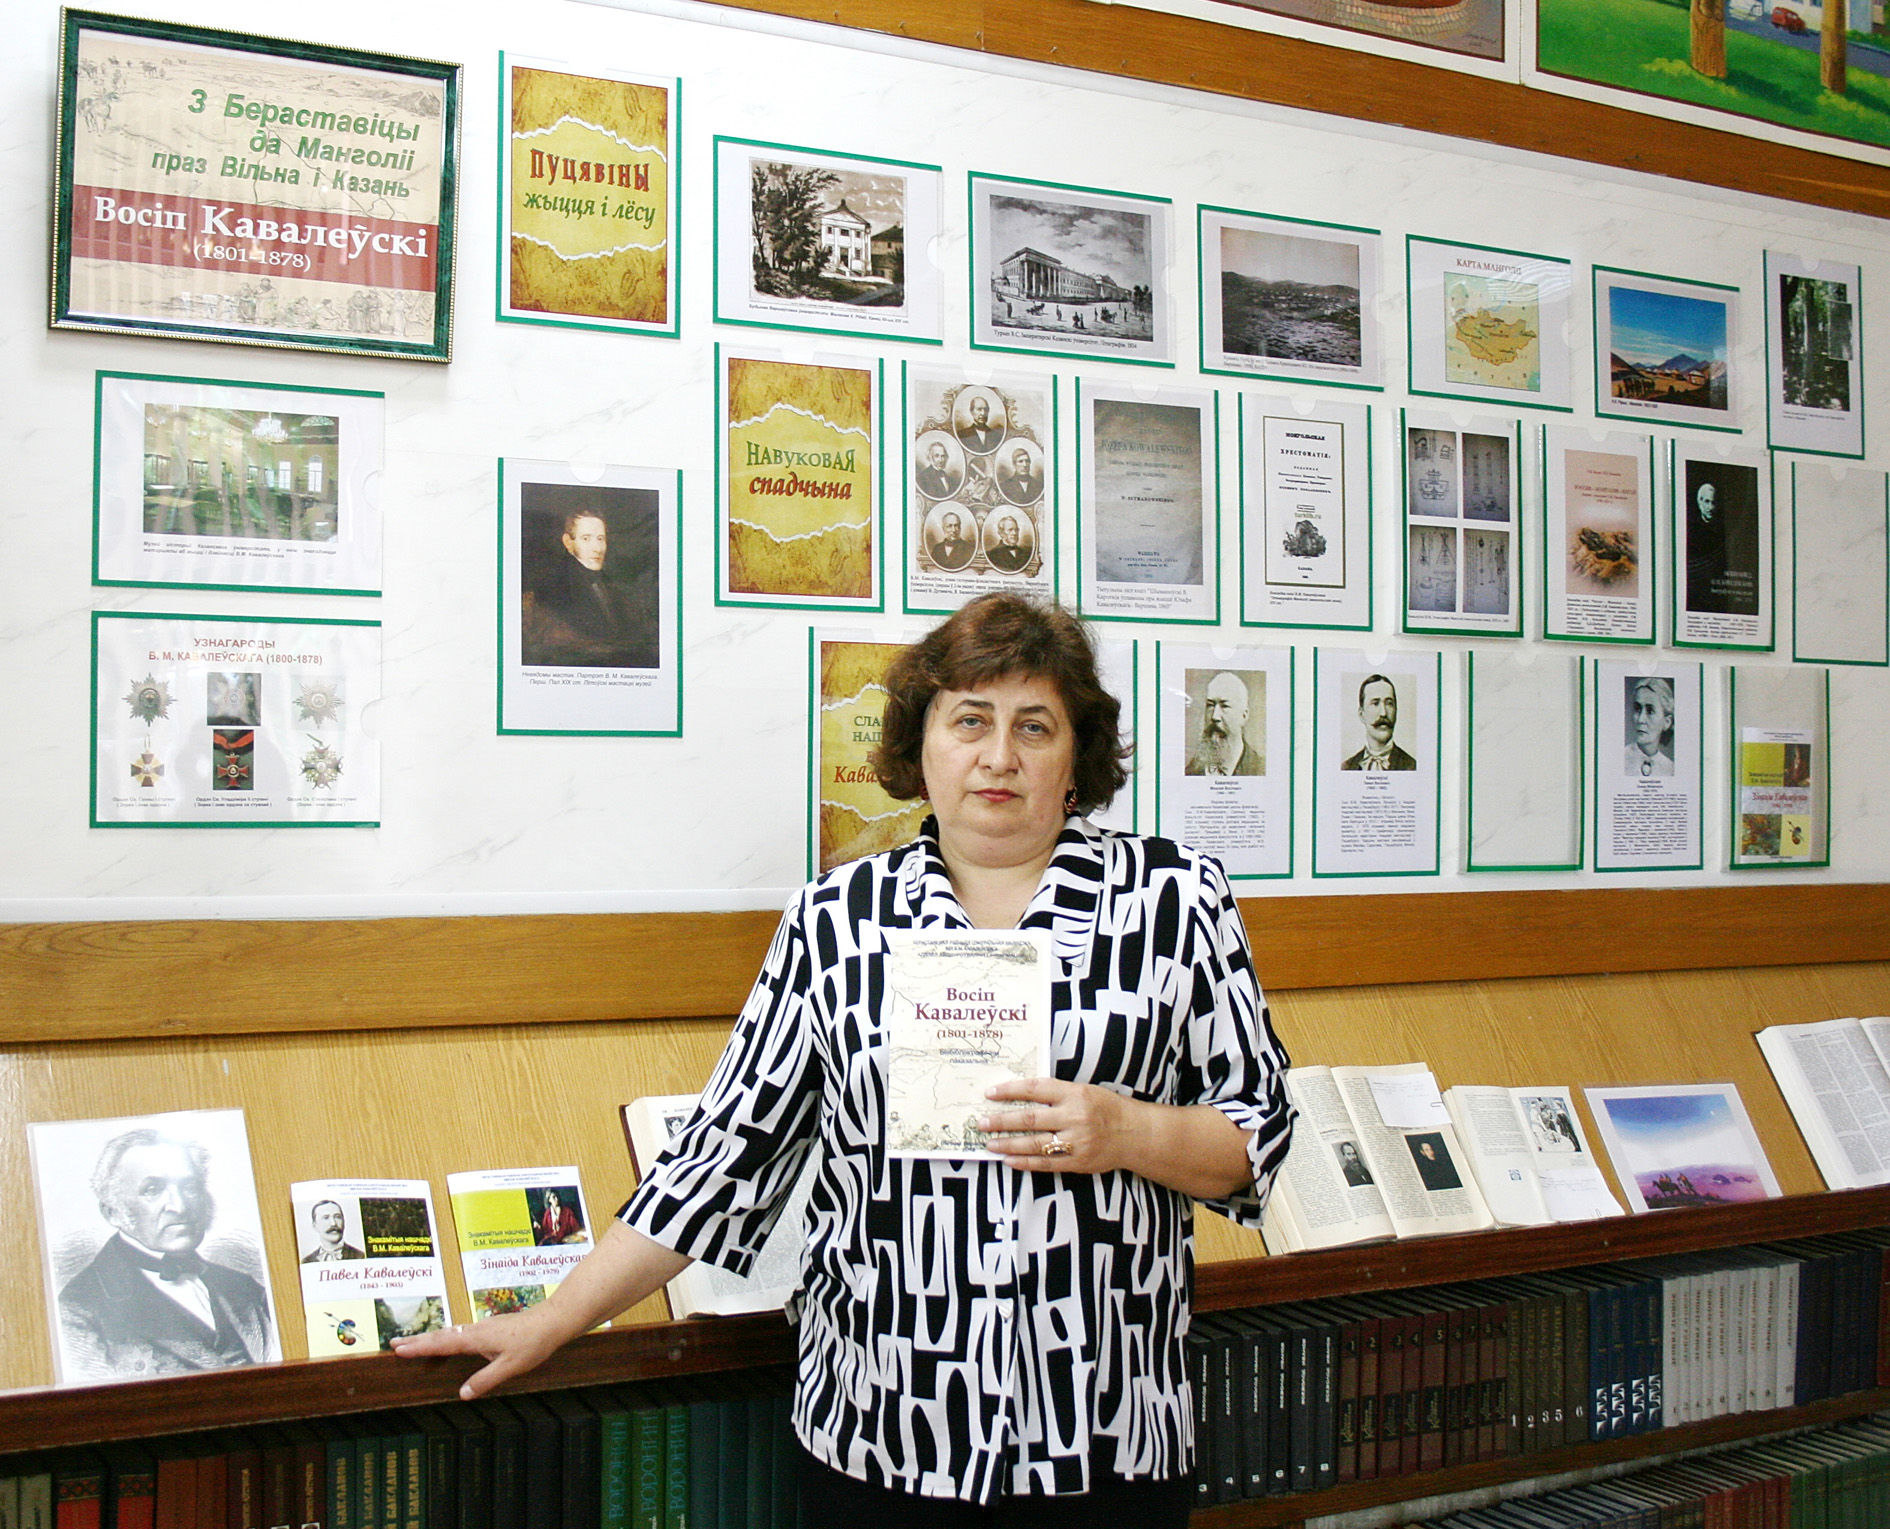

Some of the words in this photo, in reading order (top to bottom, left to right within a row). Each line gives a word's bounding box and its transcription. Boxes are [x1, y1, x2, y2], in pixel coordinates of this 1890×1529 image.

[188, 89, 207, 114] З
[223, 93, 420, 142] Бераставіцы
[249, 129, 281, 156] да
[298, 136, 415, 171] Манголіі
[152, 150, 207, 177] праз
[220, 158, 300, 187] Вільна
[313, 167, 321, 188] і
[331, 170, 411, 199] Казань
[523, 192, 595, 221] жыцця
[601, 195, 608, 217] і
[612, 200, 656, 230] лёсу
[94, 196, 187, 231] Восіп
[200, 204, 429, 260] Кавалеўскі
[193, 243, 312, 272] (1801-1878)
[1456, 258, 1482, 270] КАРТА
[749, 471, 852, 500] спадчына
[193, 638, 276, 650] УЗНАГАРОДЫ
[946, 987, 995, 1002] Восіп
[914, 1003, 1028, 1027] Кавалеўскі
[937, 1029, 1003, 1041] (1801-1878)
[372, 1244, 388, 1252] В.М.
[473, 1239, 487, 1247] В.М.
[480, 1257, 519, 1270] Зінаіда
[319, 1269, 359, 1282] Павел
[364, 1265, 433, 1281] Кавалеўскі
[1437, 1329, 1443, 1341] 5
[1370, 1337, 1376, 1348] 2
[1542, 1410, 1550, 1424] 3
[1554, 1408, 1563, 1422] 5
[1575, 1405, 1584, 1418] 6
[1511, 1414, 1517, 1427] 1
[1527, 1414, 1535, 1428] 2
[1275, 1469, 1284, 1477] 6
[1298, 1465, 1306, 1473] 7
[1320, 1462, 1329, 1471] 8
[1225, 1476, 1234, 1485] 4
[1251, 1474, 1260, 1482] 5
[1199, 1483, 1208, 1492] 3
